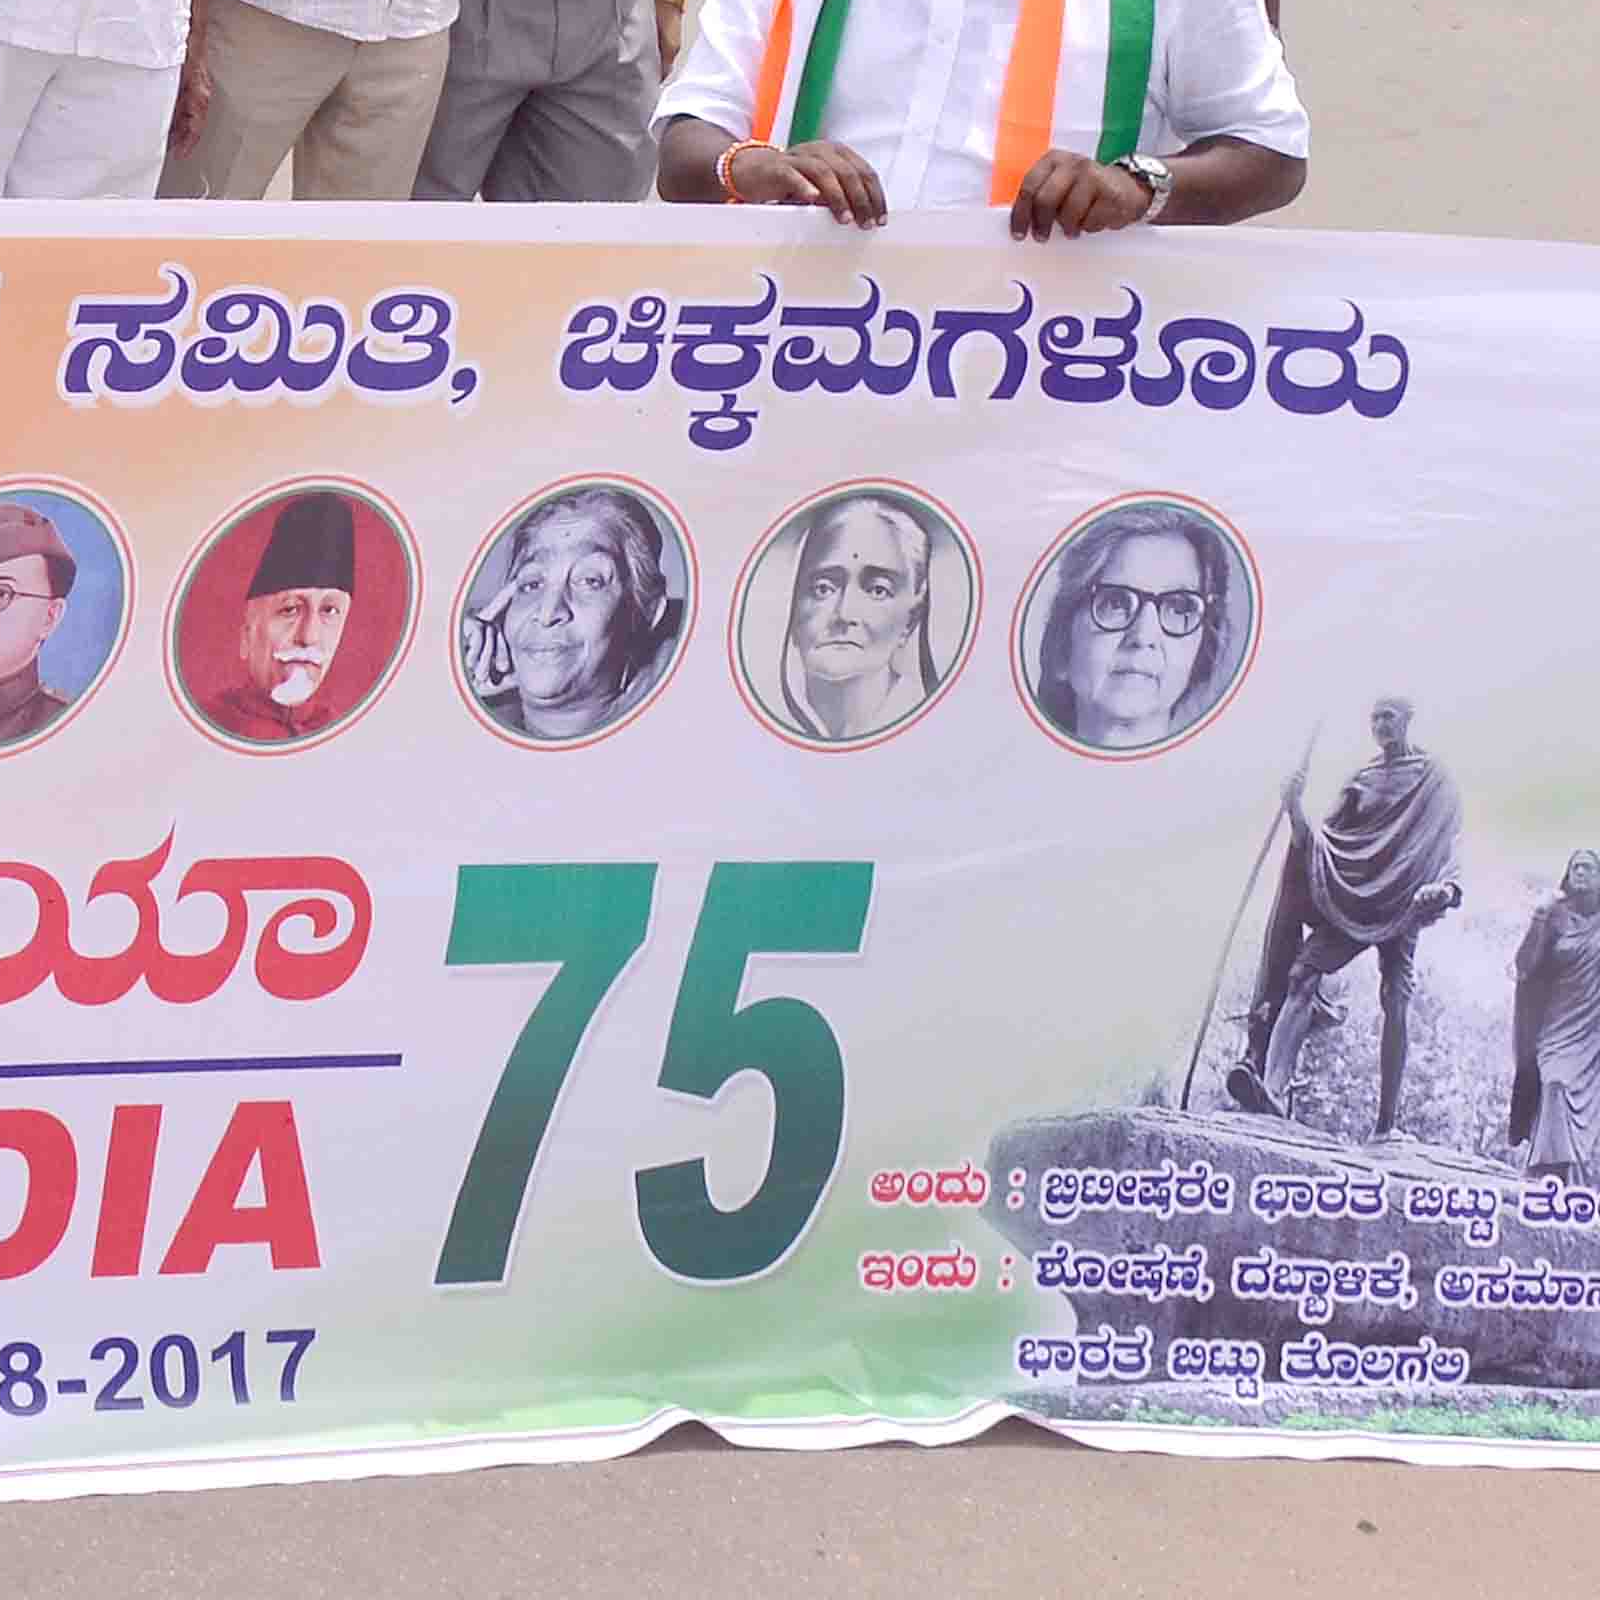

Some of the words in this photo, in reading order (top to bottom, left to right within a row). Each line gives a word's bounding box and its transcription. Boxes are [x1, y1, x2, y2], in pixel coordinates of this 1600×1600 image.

[64, 267, 480, 403] ಸಮಿತಿ,
[559, 273, 1410, 452] ಚಿಕ್ಕಮಗಳೂರು
[434, 861, 875, 1283] 75
[871, 1161, 986, 1204] ಅಂದು
[1255, 1173, 1384, 1218] ಭಾರತ
[1409, 1186, 1497, 1241] ಬಿಟ್ಟು
[862, 1247, 977, 1290] ಇಂದು
[1037, 1246, 1211, 1296] ಶೋಷಣೆ,
[1237, 1250, 1417, 1318] ದಬ್ಬಾಳಿಕೆ,
[1018, 1327, 1148, 1376] ಭಾರತ
[1173, 1342, 1260, 1398] ಬಿಟ್ಟು
[1286, 1336, 1466, 1384] ತೊಲಗಲಿ
